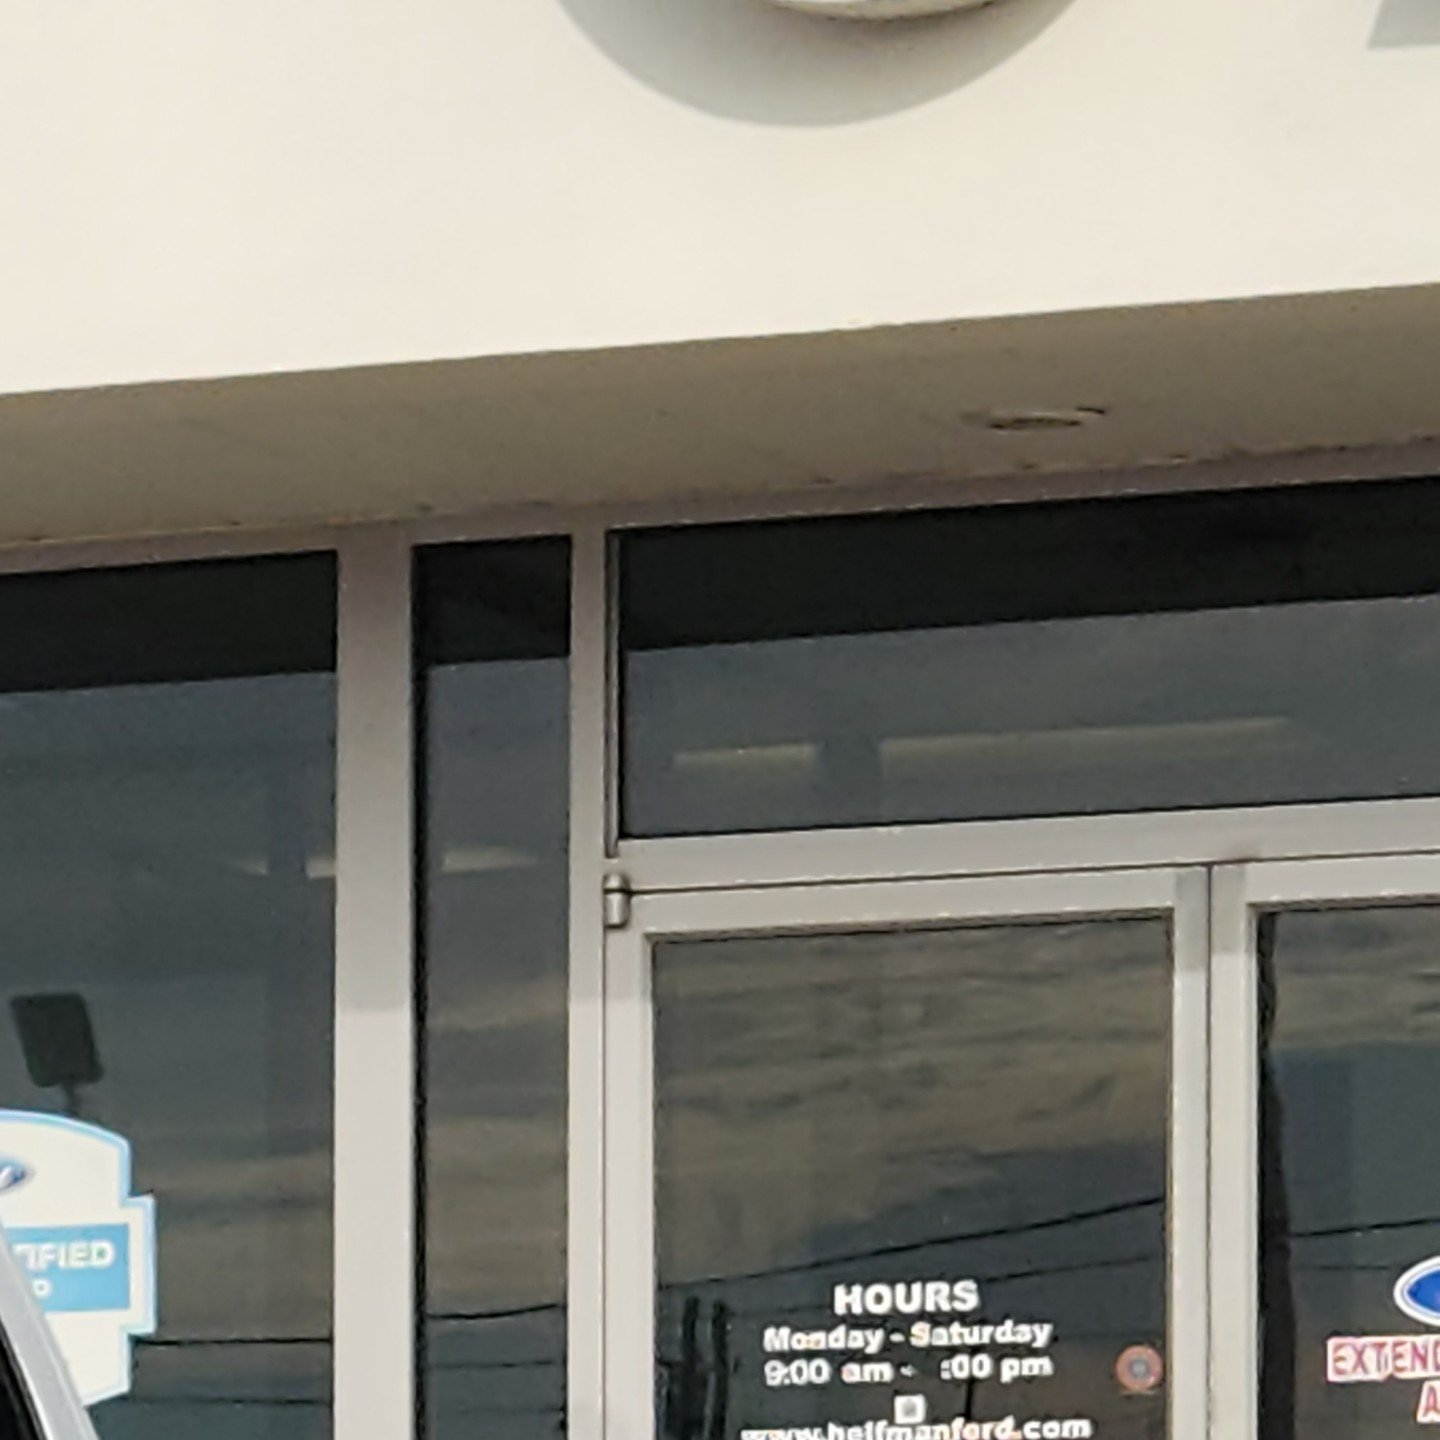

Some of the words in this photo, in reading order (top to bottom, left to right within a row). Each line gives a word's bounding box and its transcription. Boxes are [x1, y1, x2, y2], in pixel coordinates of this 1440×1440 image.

[833, 1279, 980, 1316] HOURS
[763, 1325, 885, 1354] Monday
[909, 1319, 1055, 1350] Saturday
[763, 1358, 831, 1387] 9:00
[841, 1361, 895, 1384] am
[999, 1354, 1055, 1384] pm
